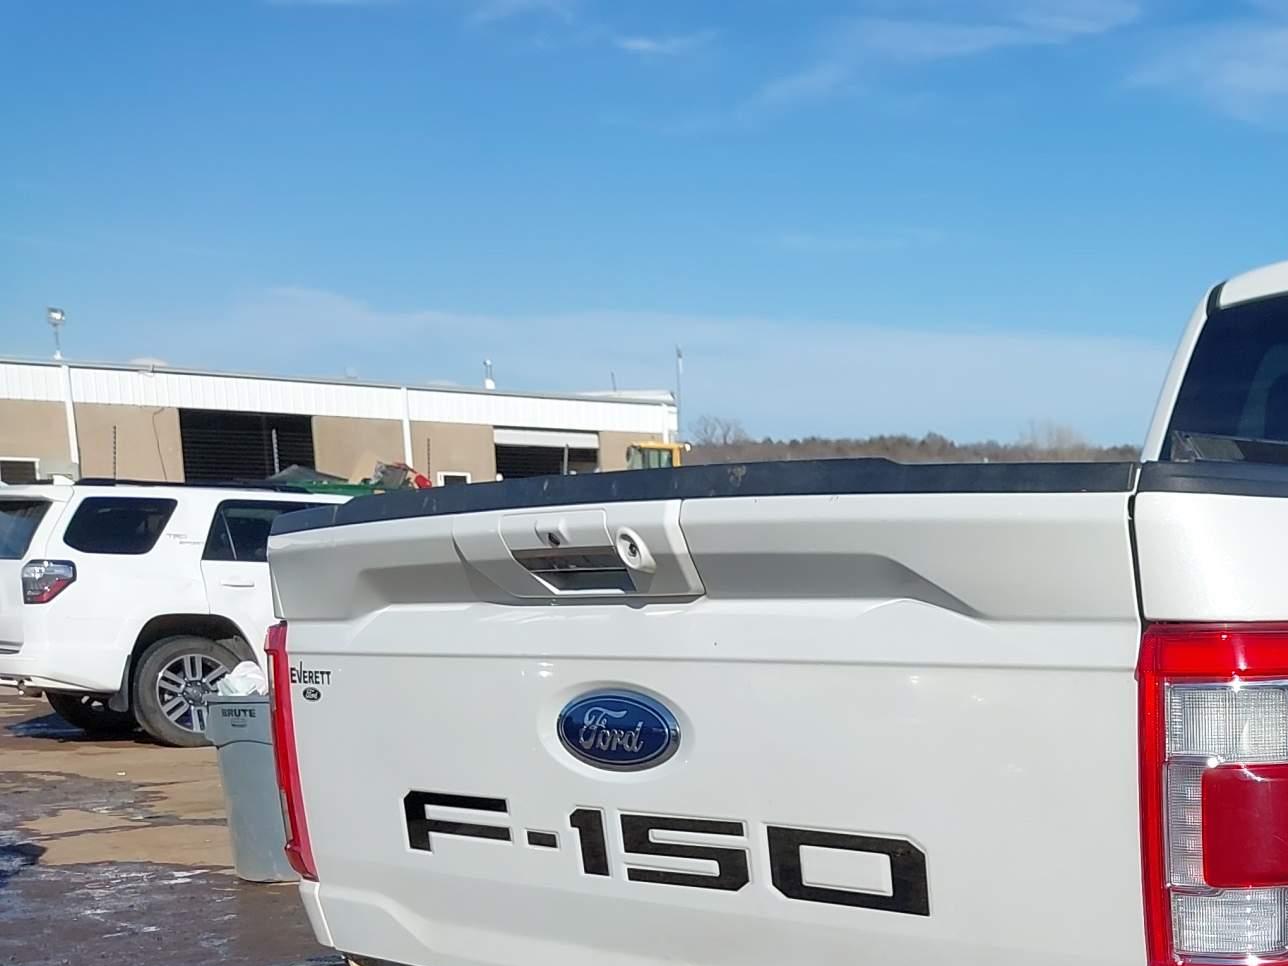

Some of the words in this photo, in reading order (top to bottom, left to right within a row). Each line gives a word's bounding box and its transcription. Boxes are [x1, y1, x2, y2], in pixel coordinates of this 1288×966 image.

[290, 661, 331, 685] EVERETT
[221, 708, 257, 718] BRUTE
[579, 706, 644, 753] Ford
[403, 790, 931, 917] F-150
